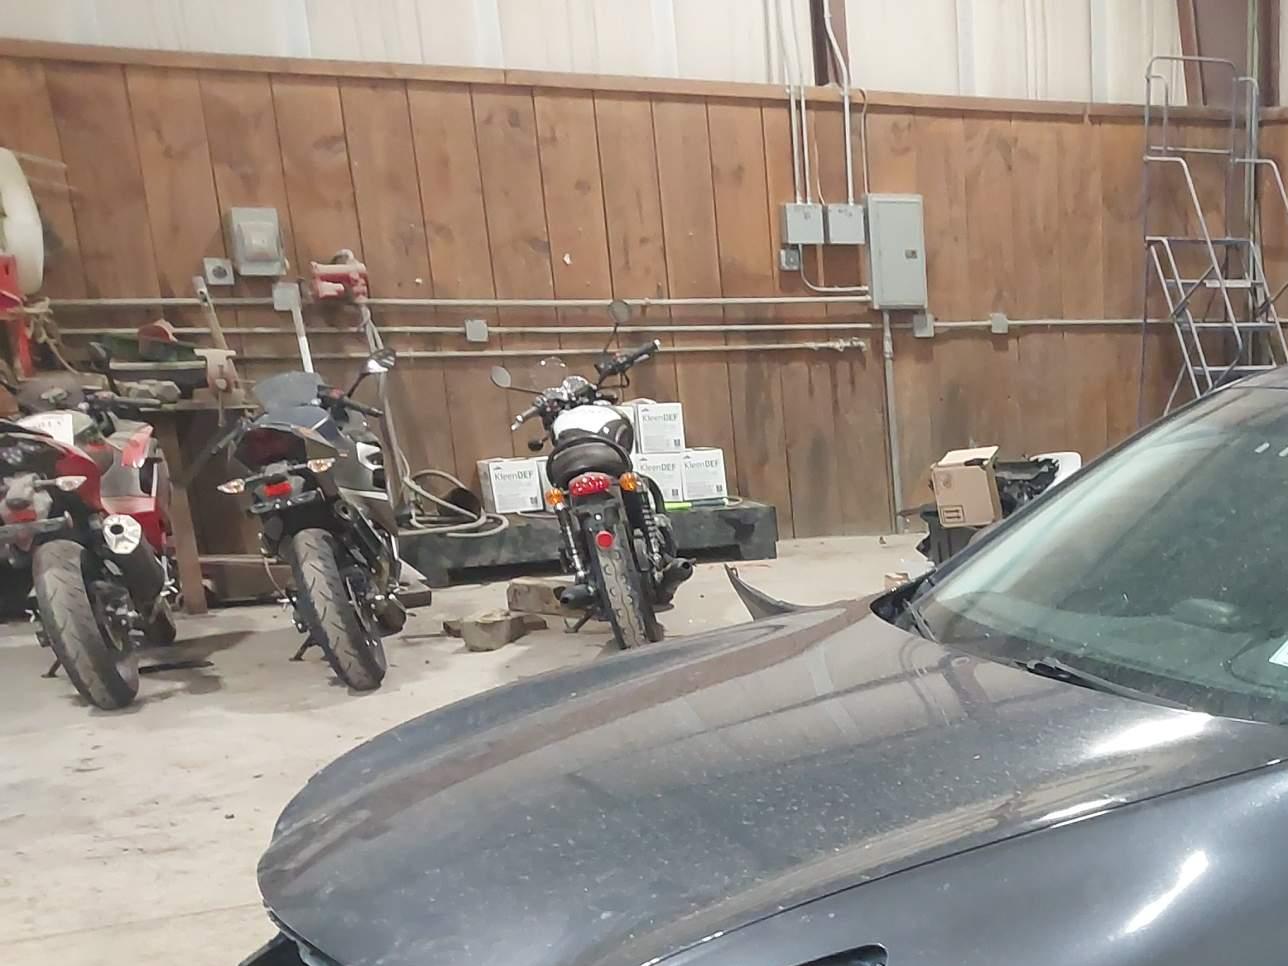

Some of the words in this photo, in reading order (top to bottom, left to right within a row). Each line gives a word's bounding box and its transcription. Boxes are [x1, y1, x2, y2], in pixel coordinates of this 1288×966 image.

[642, 413, 678, 423] KleenDEF
[640, 463, 676, 473] KleenDEF
[684, 460, 719, 470] KleenDEF
[494, 470, 533, 481] KleenDEF
